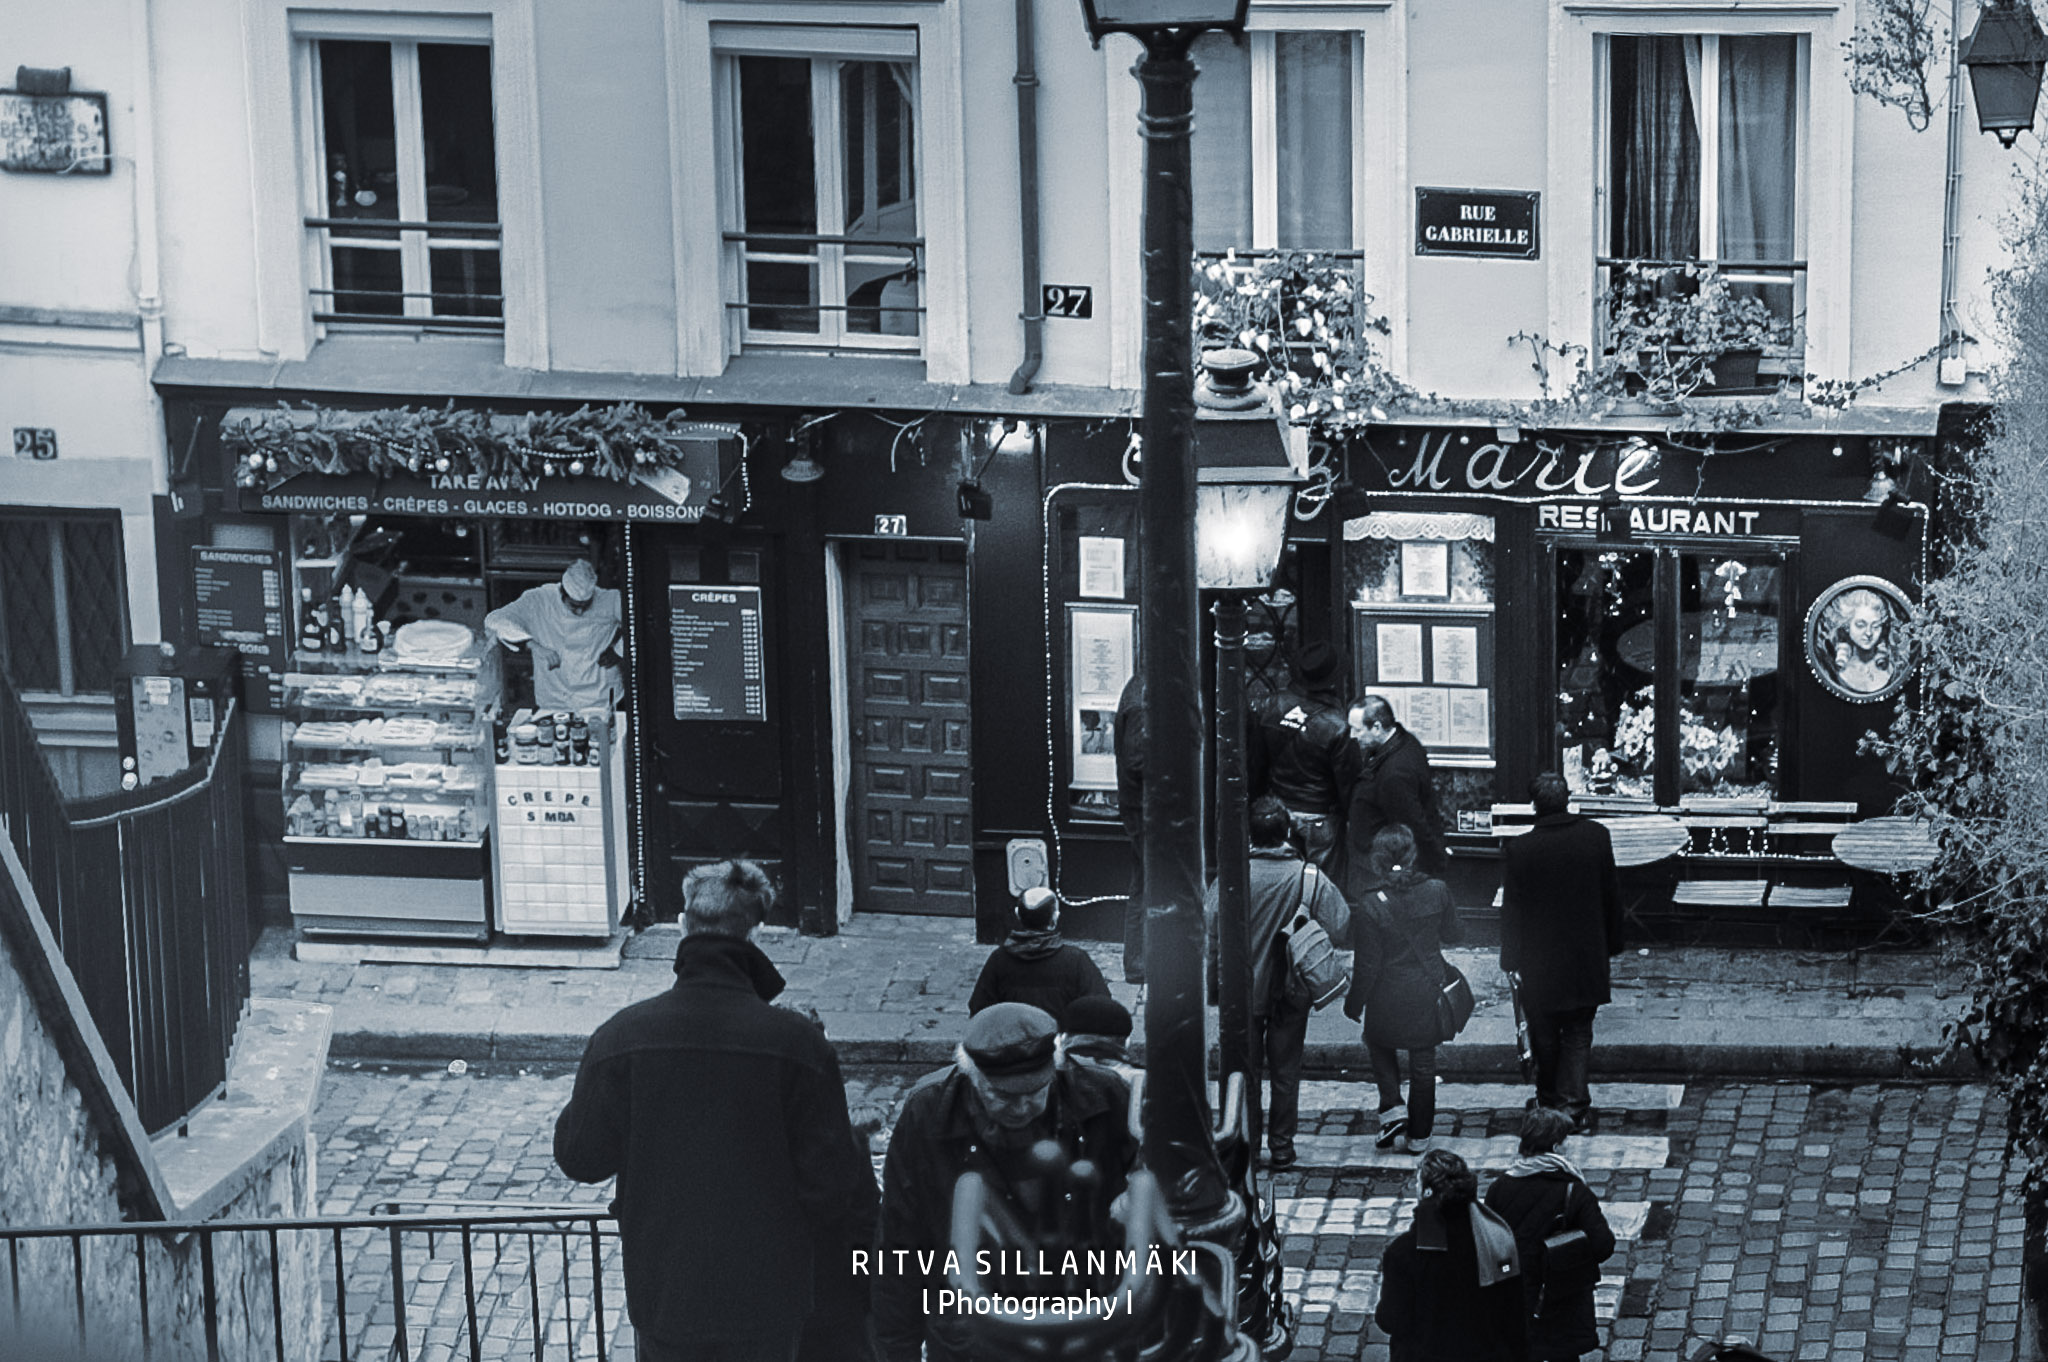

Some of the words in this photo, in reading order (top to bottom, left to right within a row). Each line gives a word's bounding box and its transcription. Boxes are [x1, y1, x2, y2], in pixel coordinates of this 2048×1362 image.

[1460, 204, 1496, 221] RUE
[1425, 225, 1529, 245] GABRIELLE
[1047, 287, 1087, 317] 27
[15, 430, 55, 458] 25
[1388, 430, 1660, 495] Marie
[428, 474, 480, 490] TAKE
[262, 496, 368, 511] SANDWICHES
[383, 496, 448, 514] CRÊPES
[464, 499, 527, 514] GLACES
[543, 502, 612, 517] HOTDOG
[879, 517, 899, 535] 27
[1538, 504, 1760, 535] RESAURANT
[200, 550, 273, 565] SANDWICHES
[691, 592, 737, 604] CRÊPES
